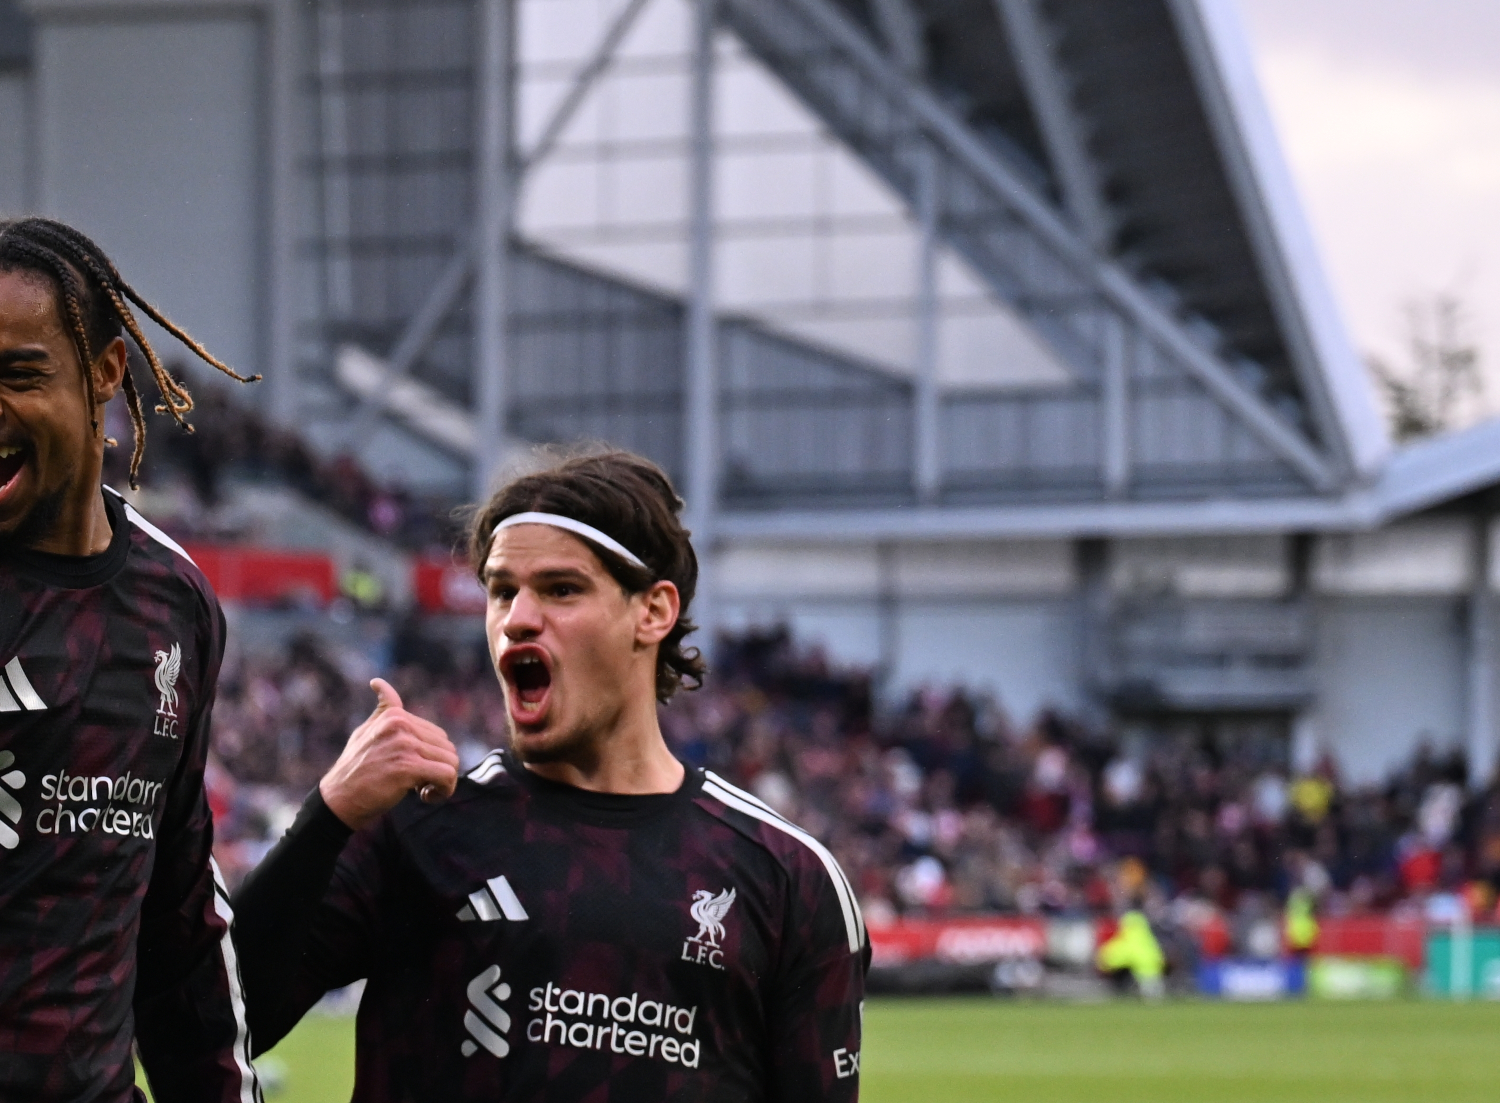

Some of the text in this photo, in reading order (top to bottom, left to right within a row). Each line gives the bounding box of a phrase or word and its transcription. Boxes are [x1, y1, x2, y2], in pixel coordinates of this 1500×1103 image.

[681, 941, 726, 971] L.F.C.
[528, 981, 698, 1036] standard
[526, 1012, 701, 1070] chartered
